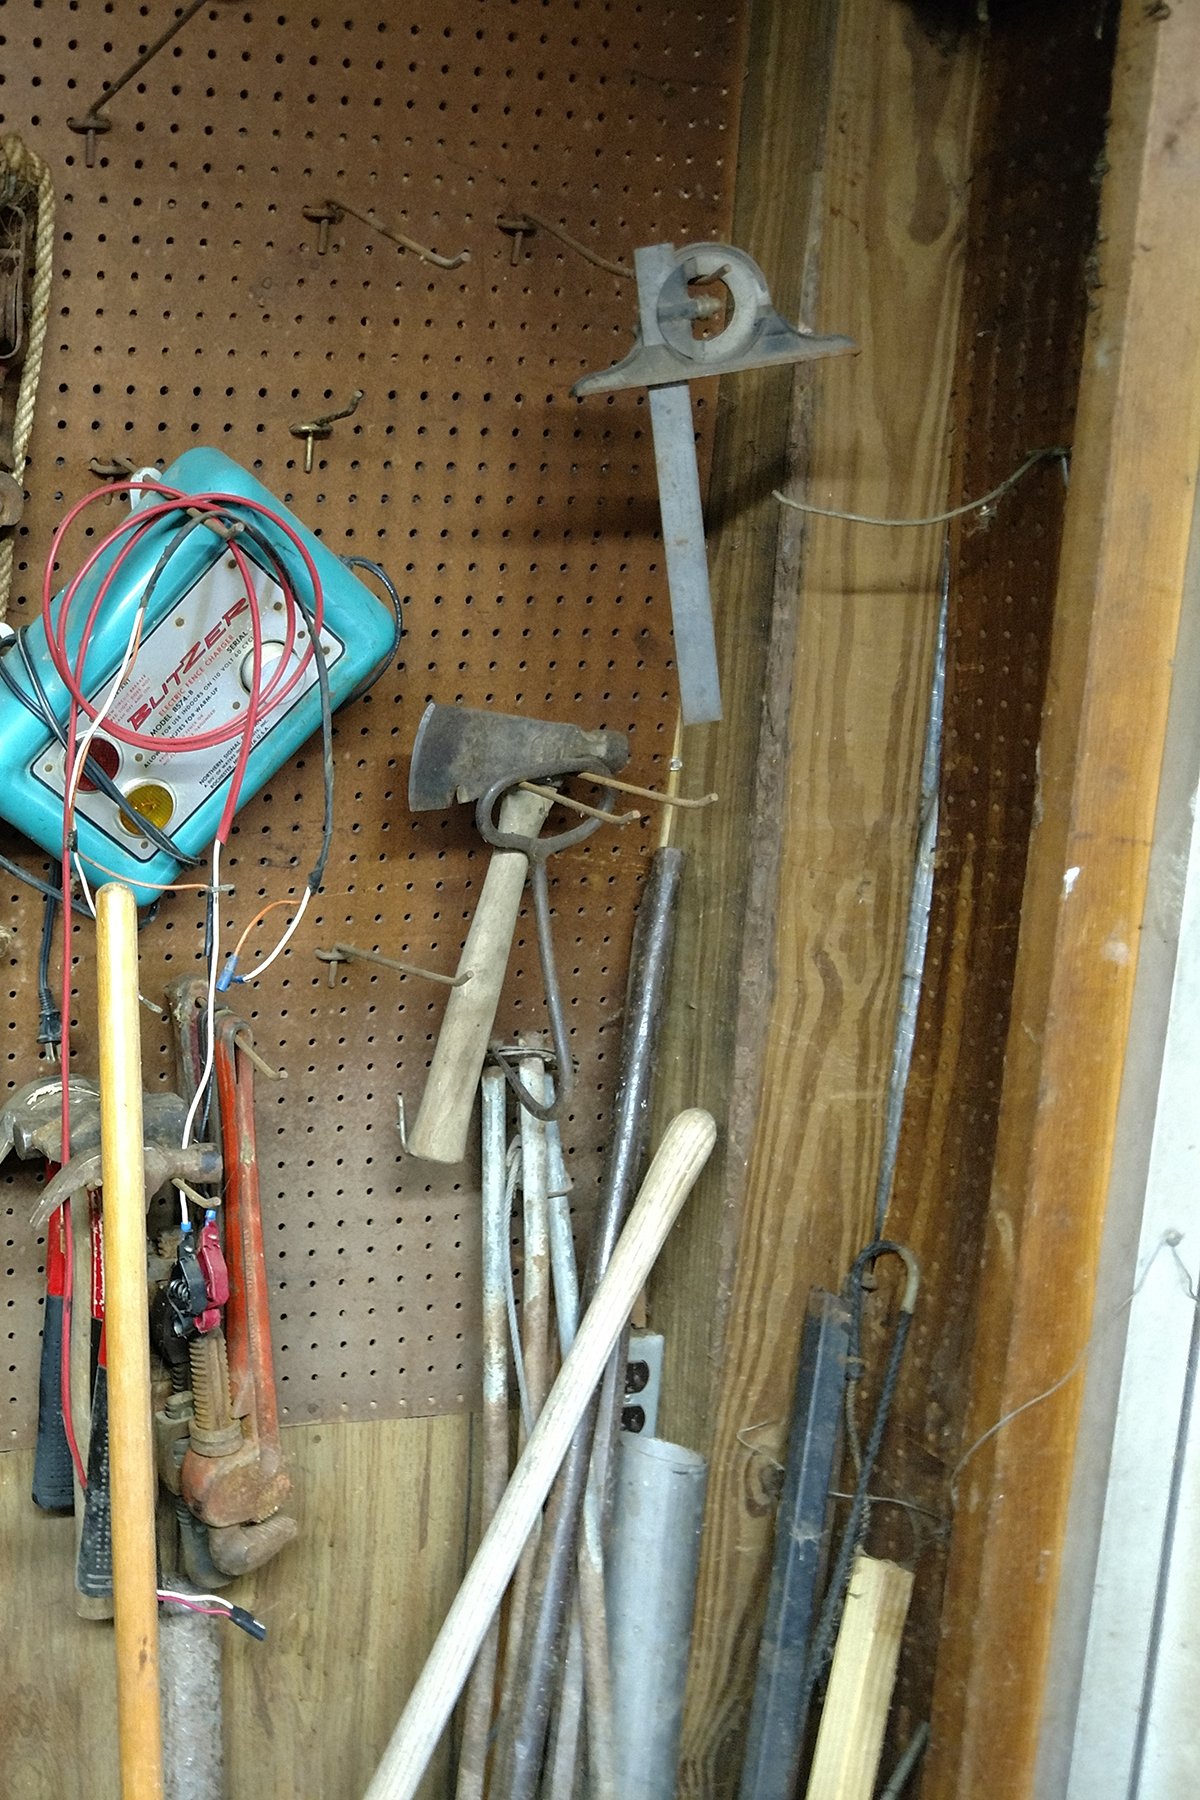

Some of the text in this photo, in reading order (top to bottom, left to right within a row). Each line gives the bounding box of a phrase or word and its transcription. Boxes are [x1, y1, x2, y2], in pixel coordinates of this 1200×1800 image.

[128, 596, 249, 730] BLITZER
[225, 629, 248, 653] SERIAL
[158, 634, 234, 717] ELECTRIC FENCE CHARGER
[161, 725, 172, 736] FOR
[171, 715, 181, 725] USE
[180, 690, 203, 715] INDOORS
[202, 681, 212, 691] ON
[211, 671, 221, 681] 110
[220, 657, 234, 671] VOLT
[233, 649, 241, 657] 60
[149, 712, 172, 737] MODEL
[184, 712, 195, 724] FOR
[194, 686, 219, 712] WARM-UP
[198, 739, 240, 785] NORTHERN SIGNAL
